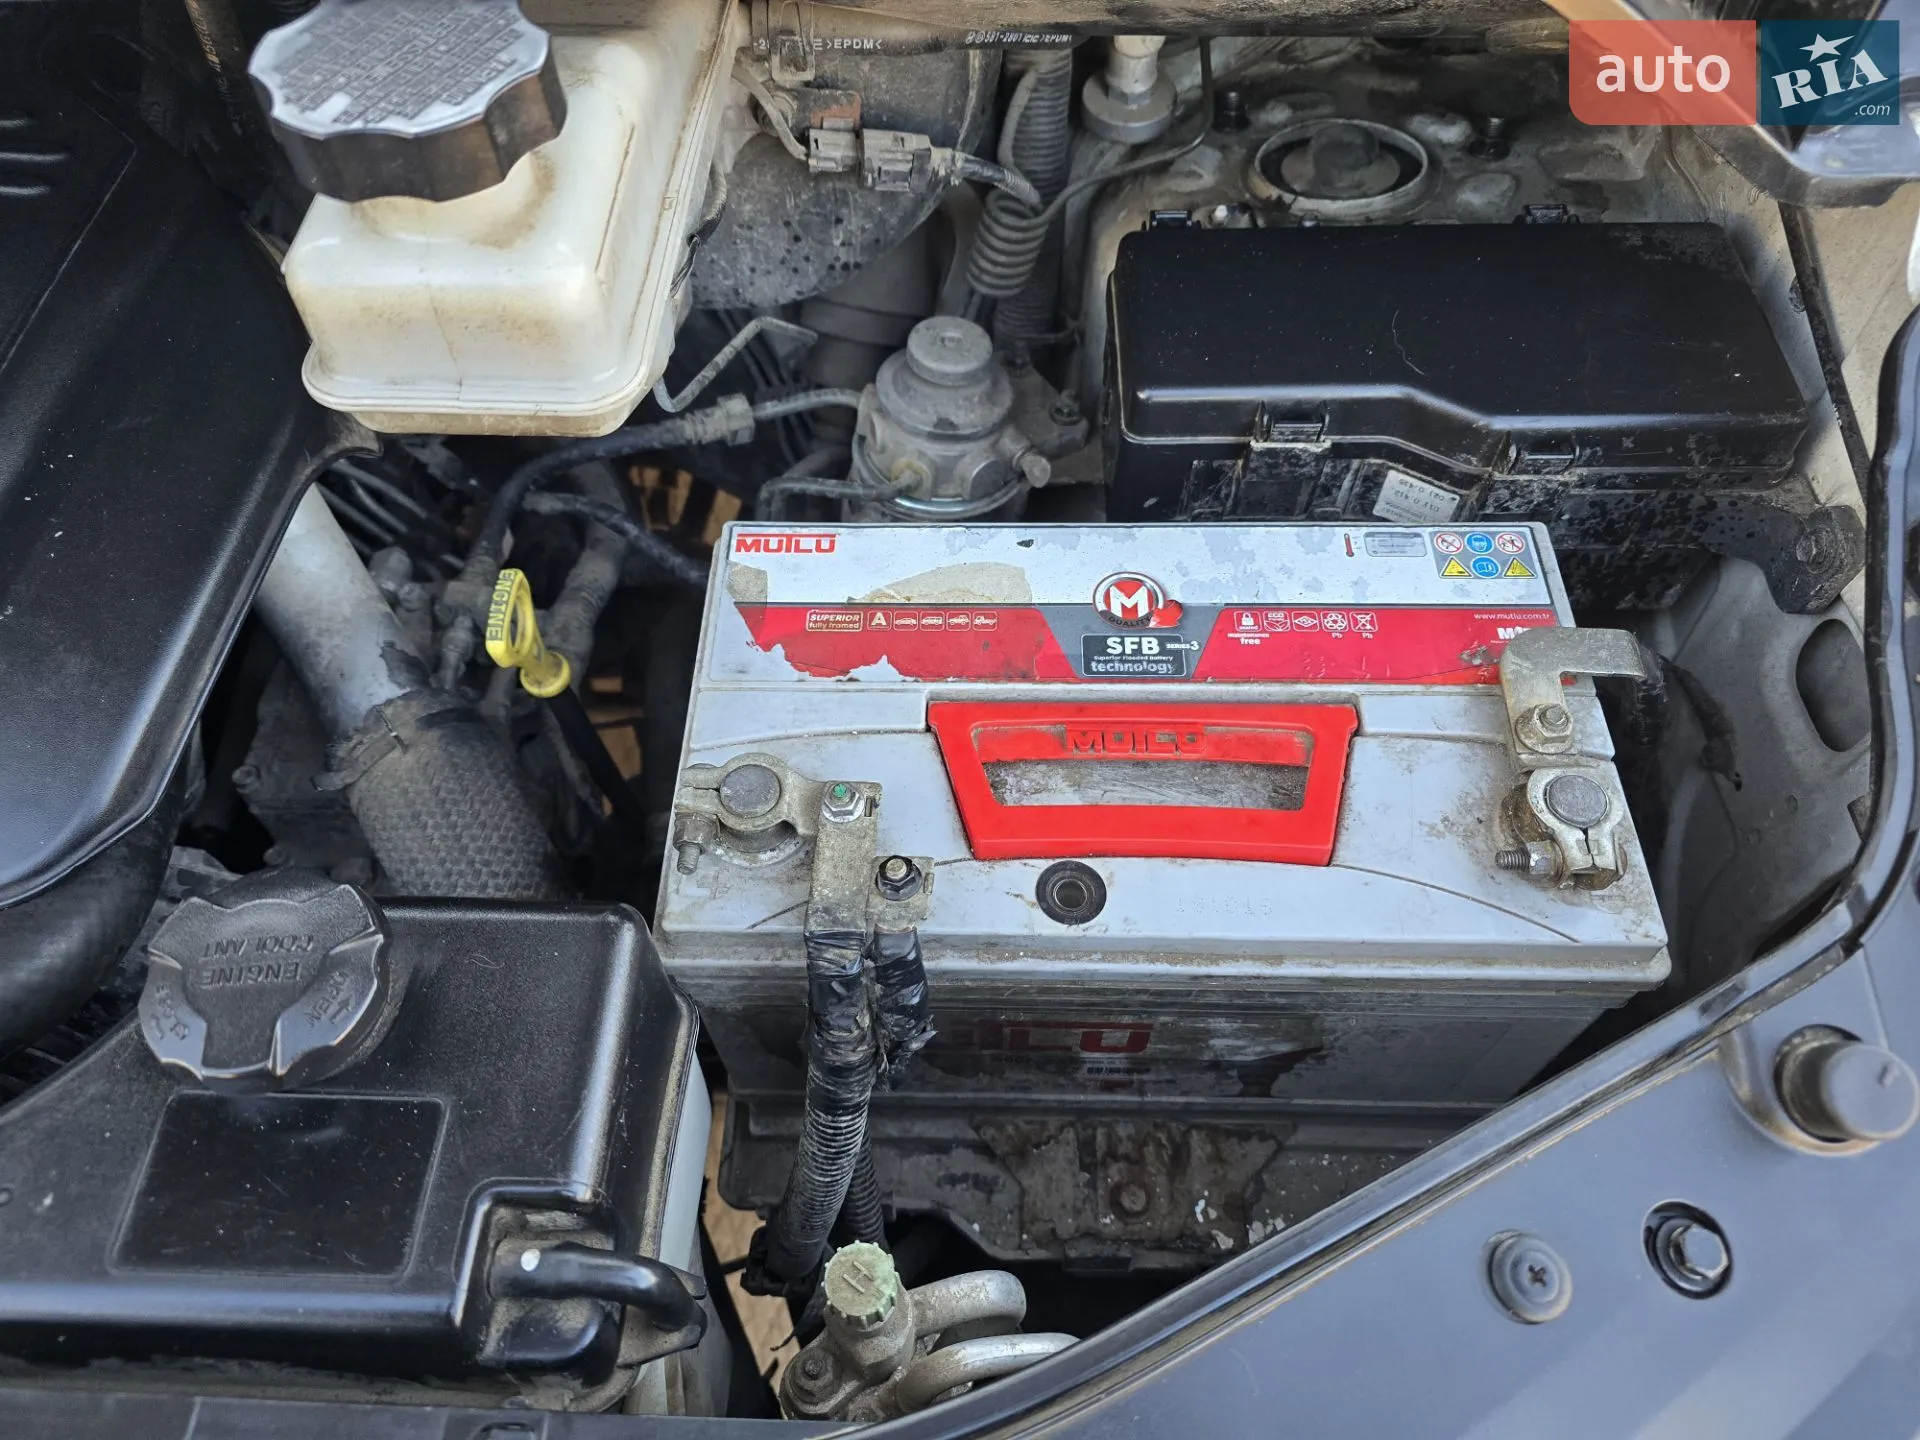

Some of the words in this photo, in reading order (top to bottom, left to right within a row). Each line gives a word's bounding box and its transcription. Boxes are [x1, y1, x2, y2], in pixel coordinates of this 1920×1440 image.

[734, 533, 837, 553] MUTLU
[486, 569, 516, 642] ENGINE
[809, 613, 860, 622] SUPERIOR
[871, 612, 887, 626] A
[1108, 615, 1152, 628] QUALITY
[1473, 612, 1551, 620] www.mutlu.com.tr
[808, 622, 827, 630] fully
[828, 622, 860, 630] framed
[1106, 636, 1160, 655] SFB
[1190, 640, 1200, 651] 3
[1090, 660, 1175, 674] technology
[201, 961, 303, 989] ENGINE
